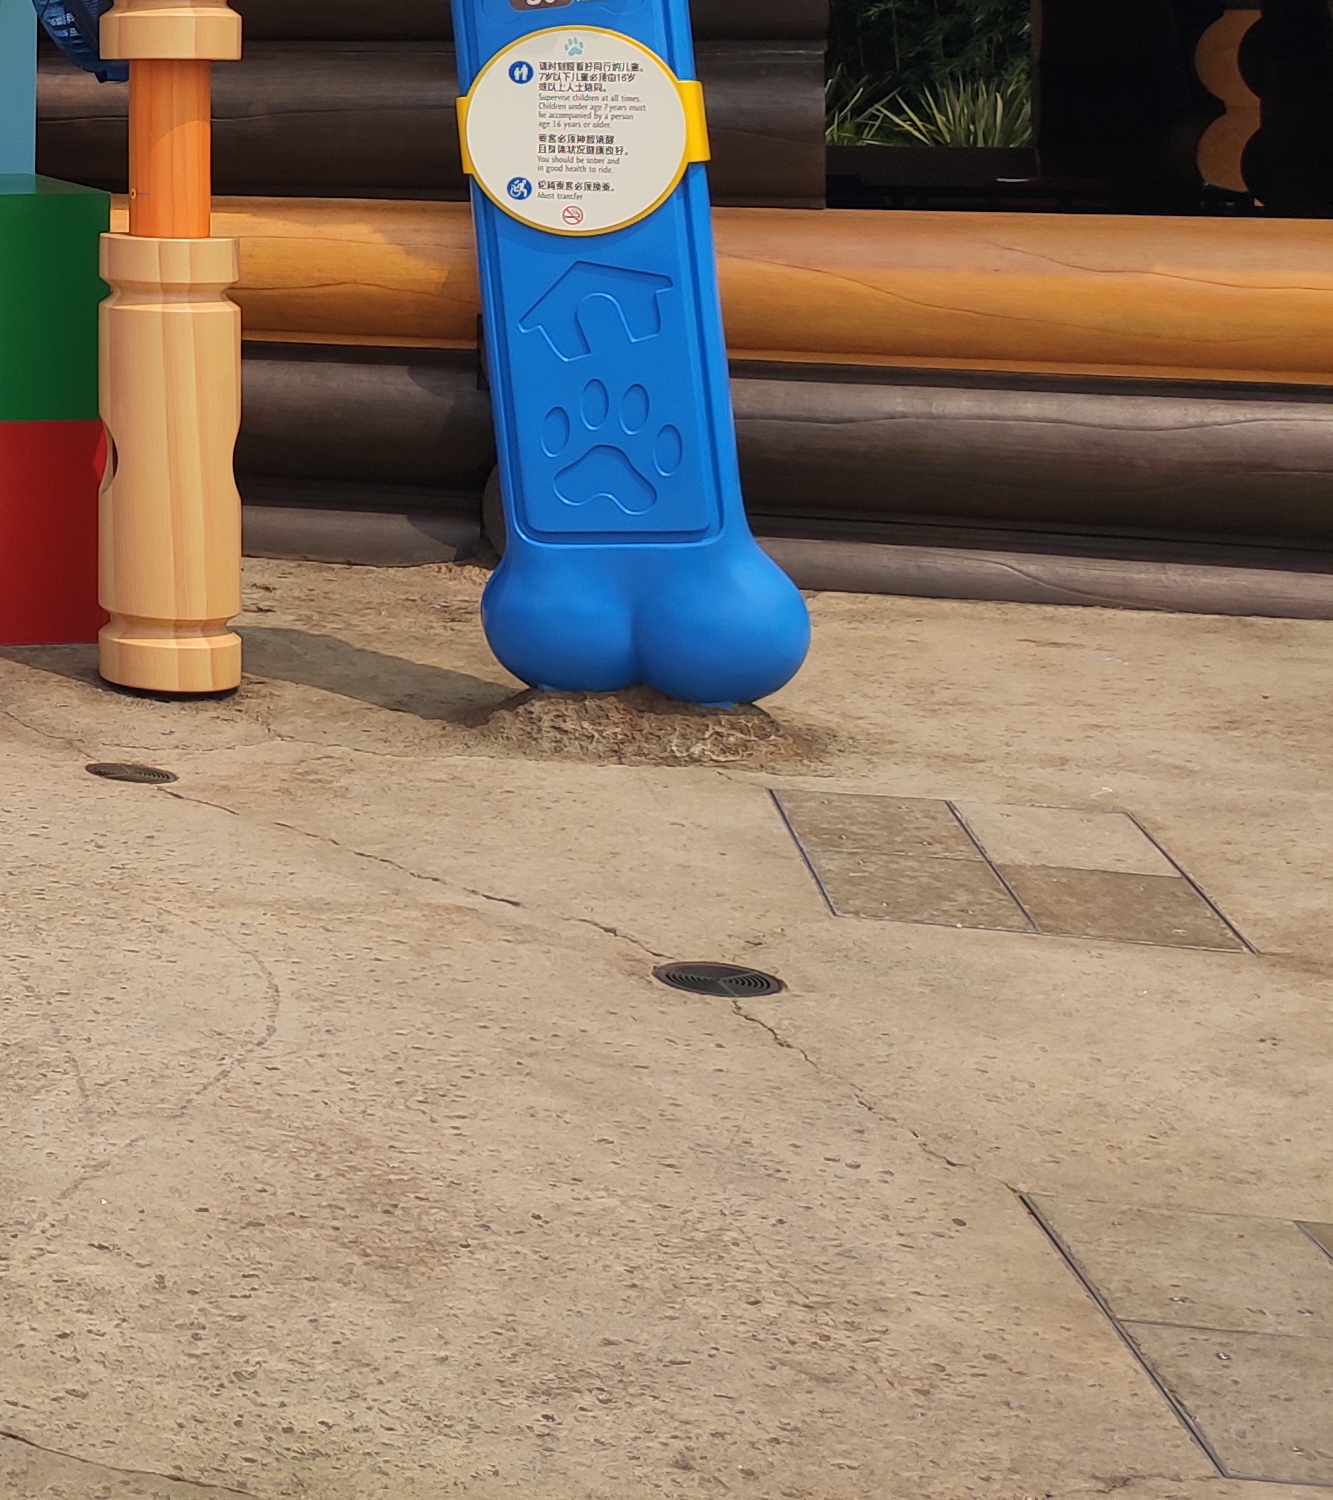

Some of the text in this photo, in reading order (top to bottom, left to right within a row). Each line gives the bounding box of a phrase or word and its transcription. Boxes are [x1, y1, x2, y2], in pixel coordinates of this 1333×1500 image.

[538, 102, 566, 110] Children
[590, 105, 602, 113] age
[608, 105, 627, 113] years
[548, 112, 591, 121] accompanied
[610, 114, 634, 122] person
[538, 122, 550, 130] age
[563, 122, 581, 130] years
[546, 165, 563, 173] good
